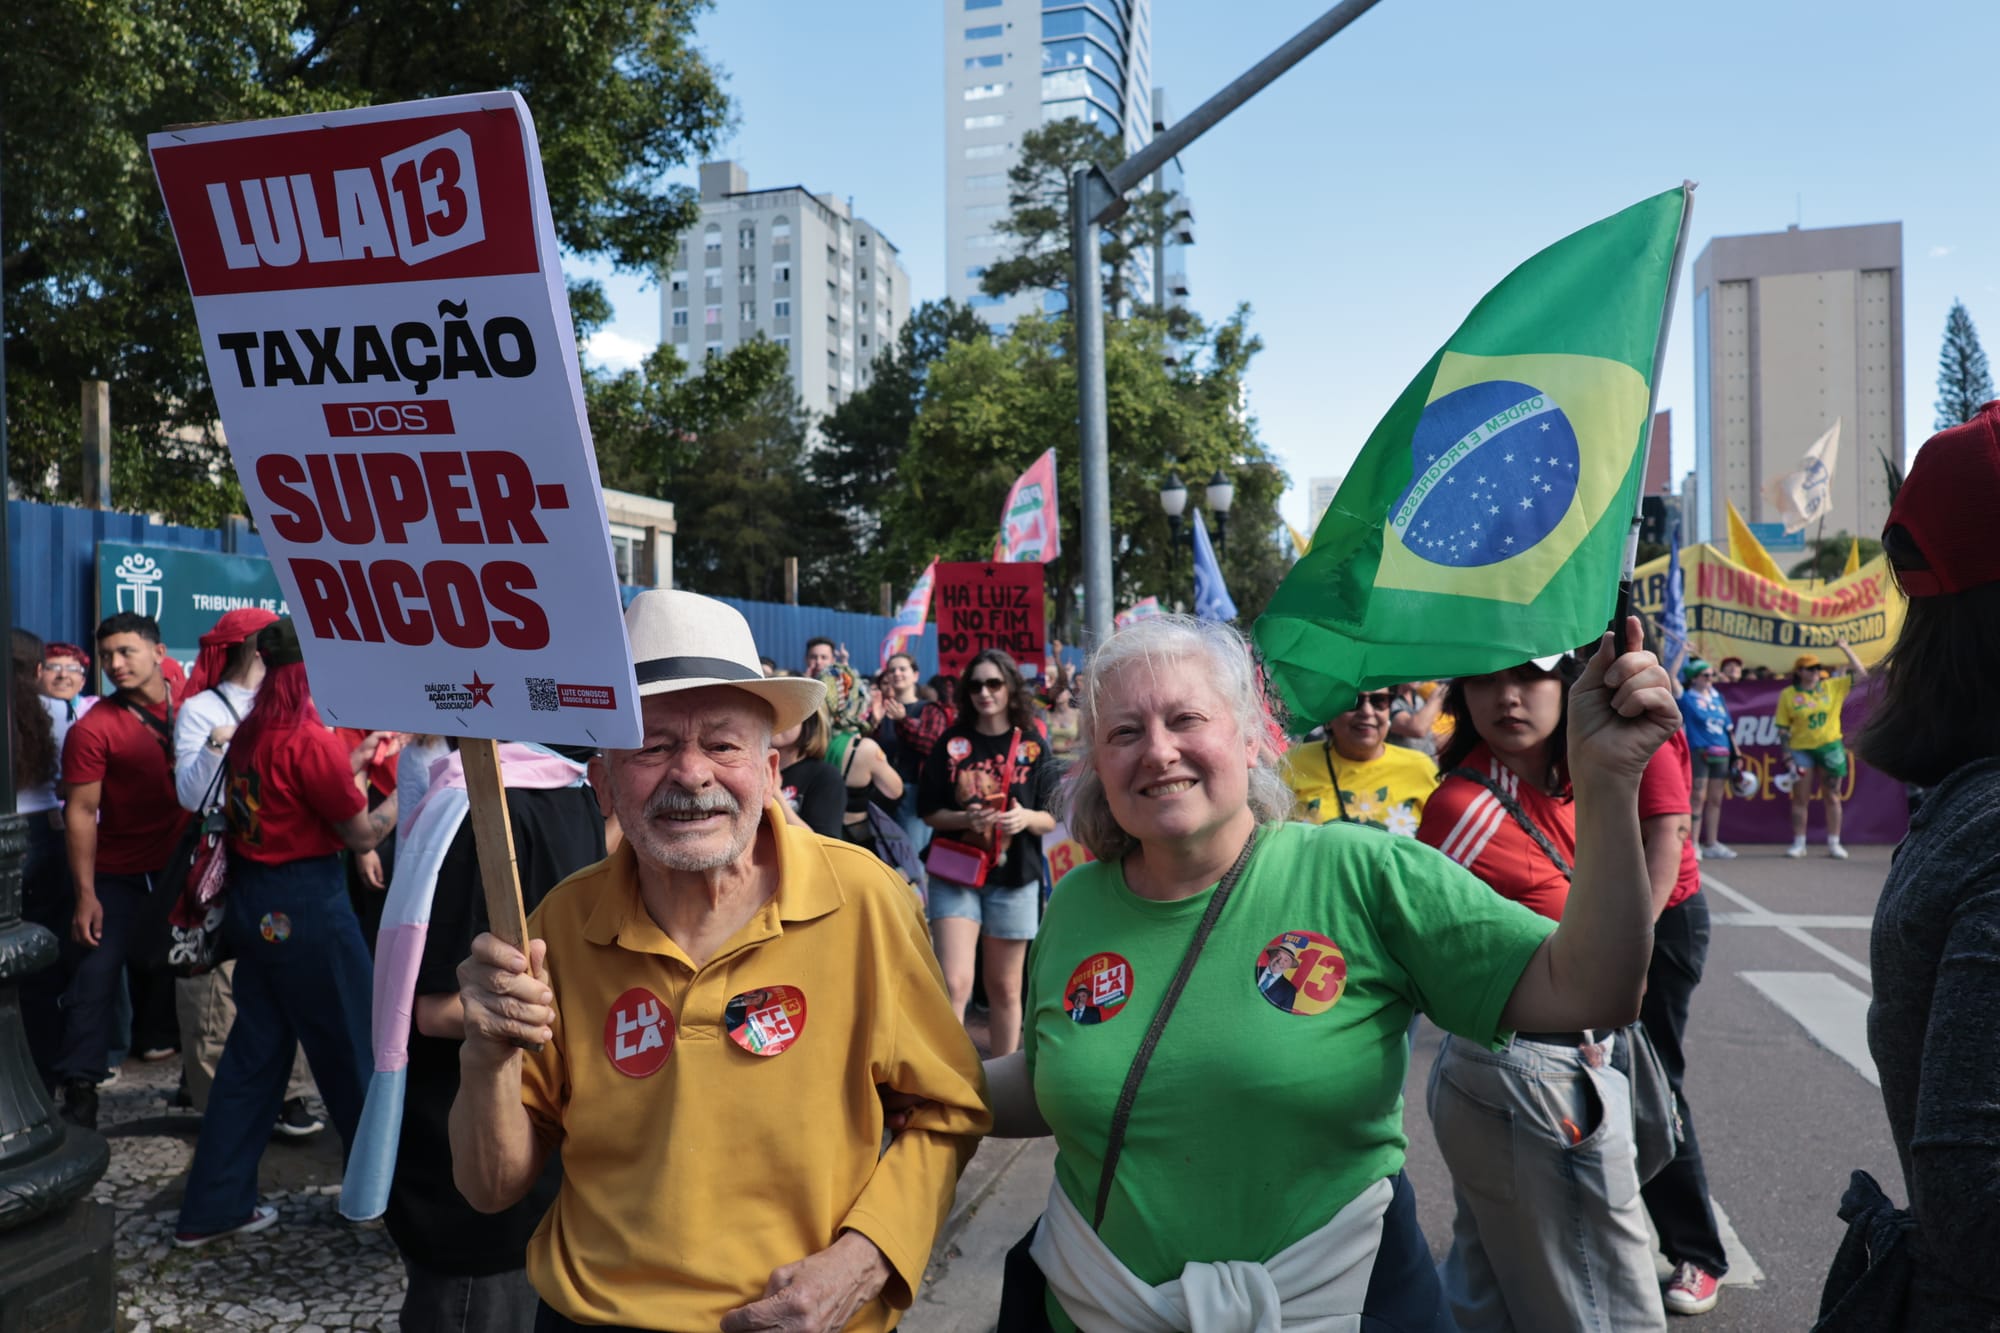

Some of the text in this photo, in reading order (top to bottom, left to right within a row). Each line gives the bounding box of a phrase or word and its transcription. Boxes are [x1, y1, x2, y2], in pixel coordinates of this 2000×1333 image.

[206, 147, 468, 270] LULA 13
[218, 299, 537, 395] TAXAÇÃO
[348, 405, 428, 432] DOS
[256, 451, 570, 545] SUPER-
[192, 594, 254, 613] TRIBUNAL
[260, 598, 277, 613] DE
[977, 585, 1031, 608] LUIZ
[1697, 562, 1799, 615] NUNCA
[288, 558, 550, 650] RICOS
[953, 609, 1029, 631] NO FIM
[1701, 607, 1775, 643] BARRAR
[1779, 622, 1795, 645] O
[1798, 614, 1884, 648] FASCISMO
[938, 633, 969, 654] DO
[475, 688, 484, 696] PT
[561, 688, 576, 697] LUTE
[1735, 716, 1780, 746] RU
[1051, 843, 1074, 885] 13
[1096, 966, 1122, 986] LU
[1096, 980, 1122, 997] LA
[1291, 948, 1346, 1002] 13
[616, 999, 661, 1036] LU
[755, 1011, 778, 1041] LA
[768, 1006, 791, 1035] LU
[615, 1024, 664, 1061] LA
